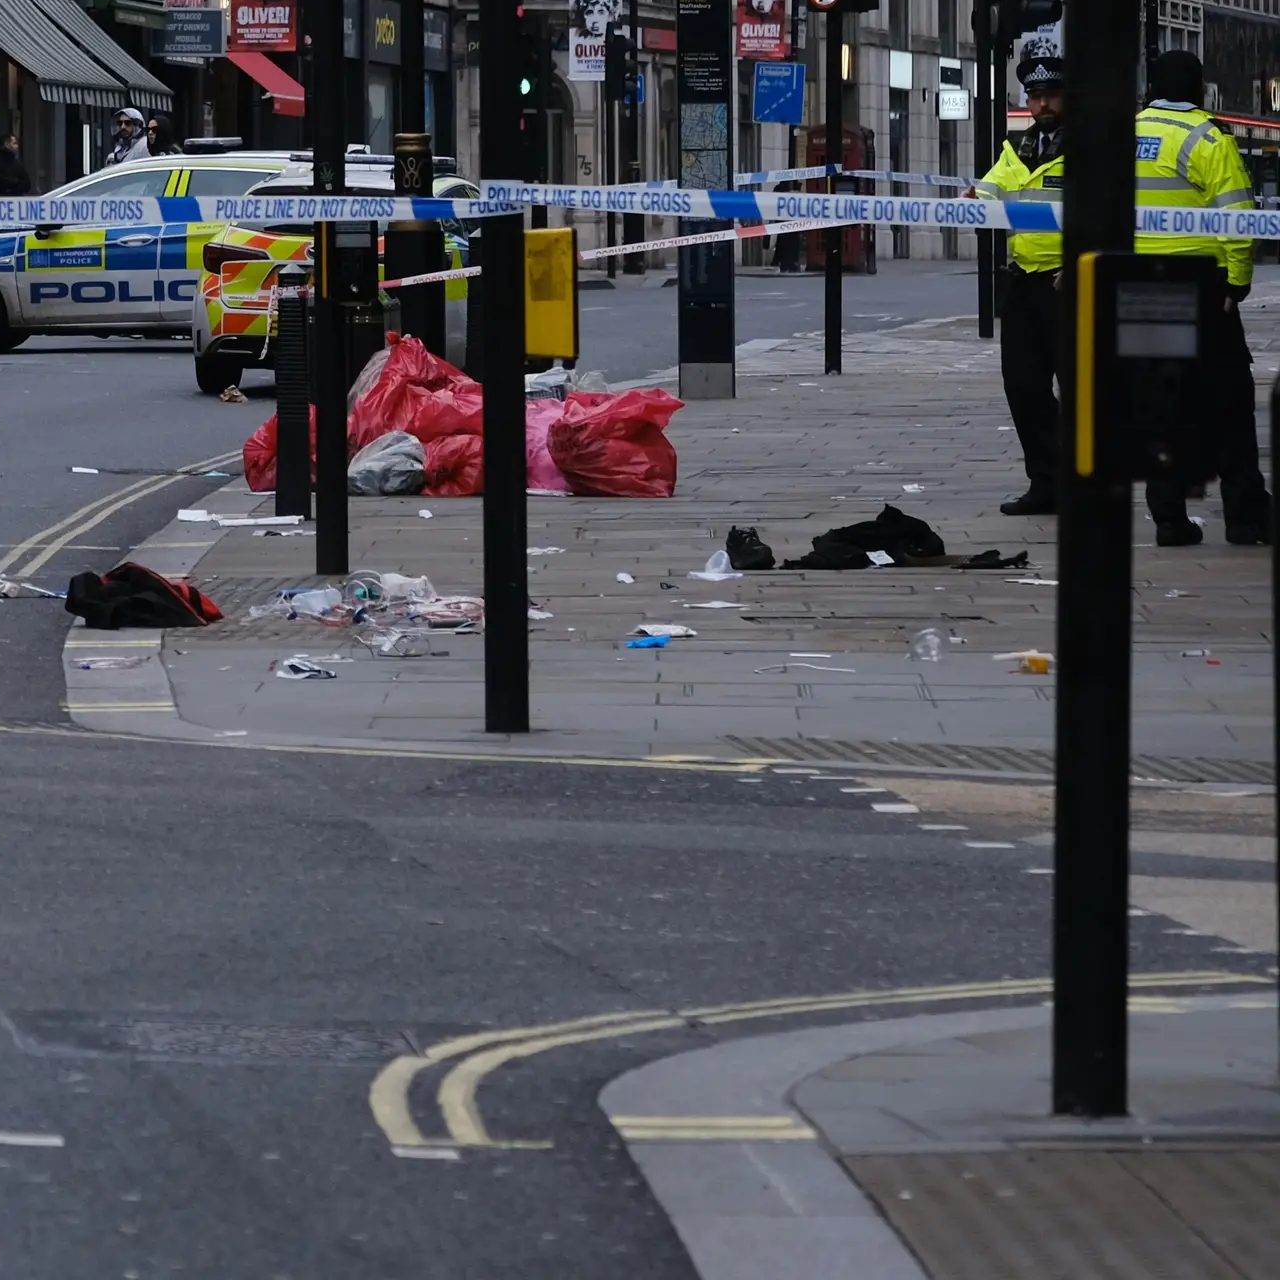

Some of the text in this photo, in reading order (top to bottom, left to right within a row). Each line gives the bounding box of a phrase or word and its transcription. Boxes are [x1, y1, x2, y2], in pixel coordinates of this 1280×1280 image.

[237, 6, 290, 25] OLIVER!
[741, 23, 781, 38] OLIVER!
[575, 44, 607, 58] OLIVE
[941, 96, 966, 108] M&S
[1136, 144, 1159, 159] ICE
[17, 201, 46, 221] LINE
[50, 200, 67, 220] DO
[70, 200, 96, 220] NOT
[100, 200, 143, 220] CROSS
[216, 198, 395, 220] POLICE LINE DO NOT CROSS
[488, 188, 691, 213] POLICE LINE DO NOT CROSS
[777, 198, 986, 224] POLICE LINE DO NOT CROSS
[1173, 211, 1194, 233] DO
[1200, 212, 1231, 234] NOT
[53, 250, 99, 258] METROPOLITAN
[29, 279, 200, 304] POLIC
